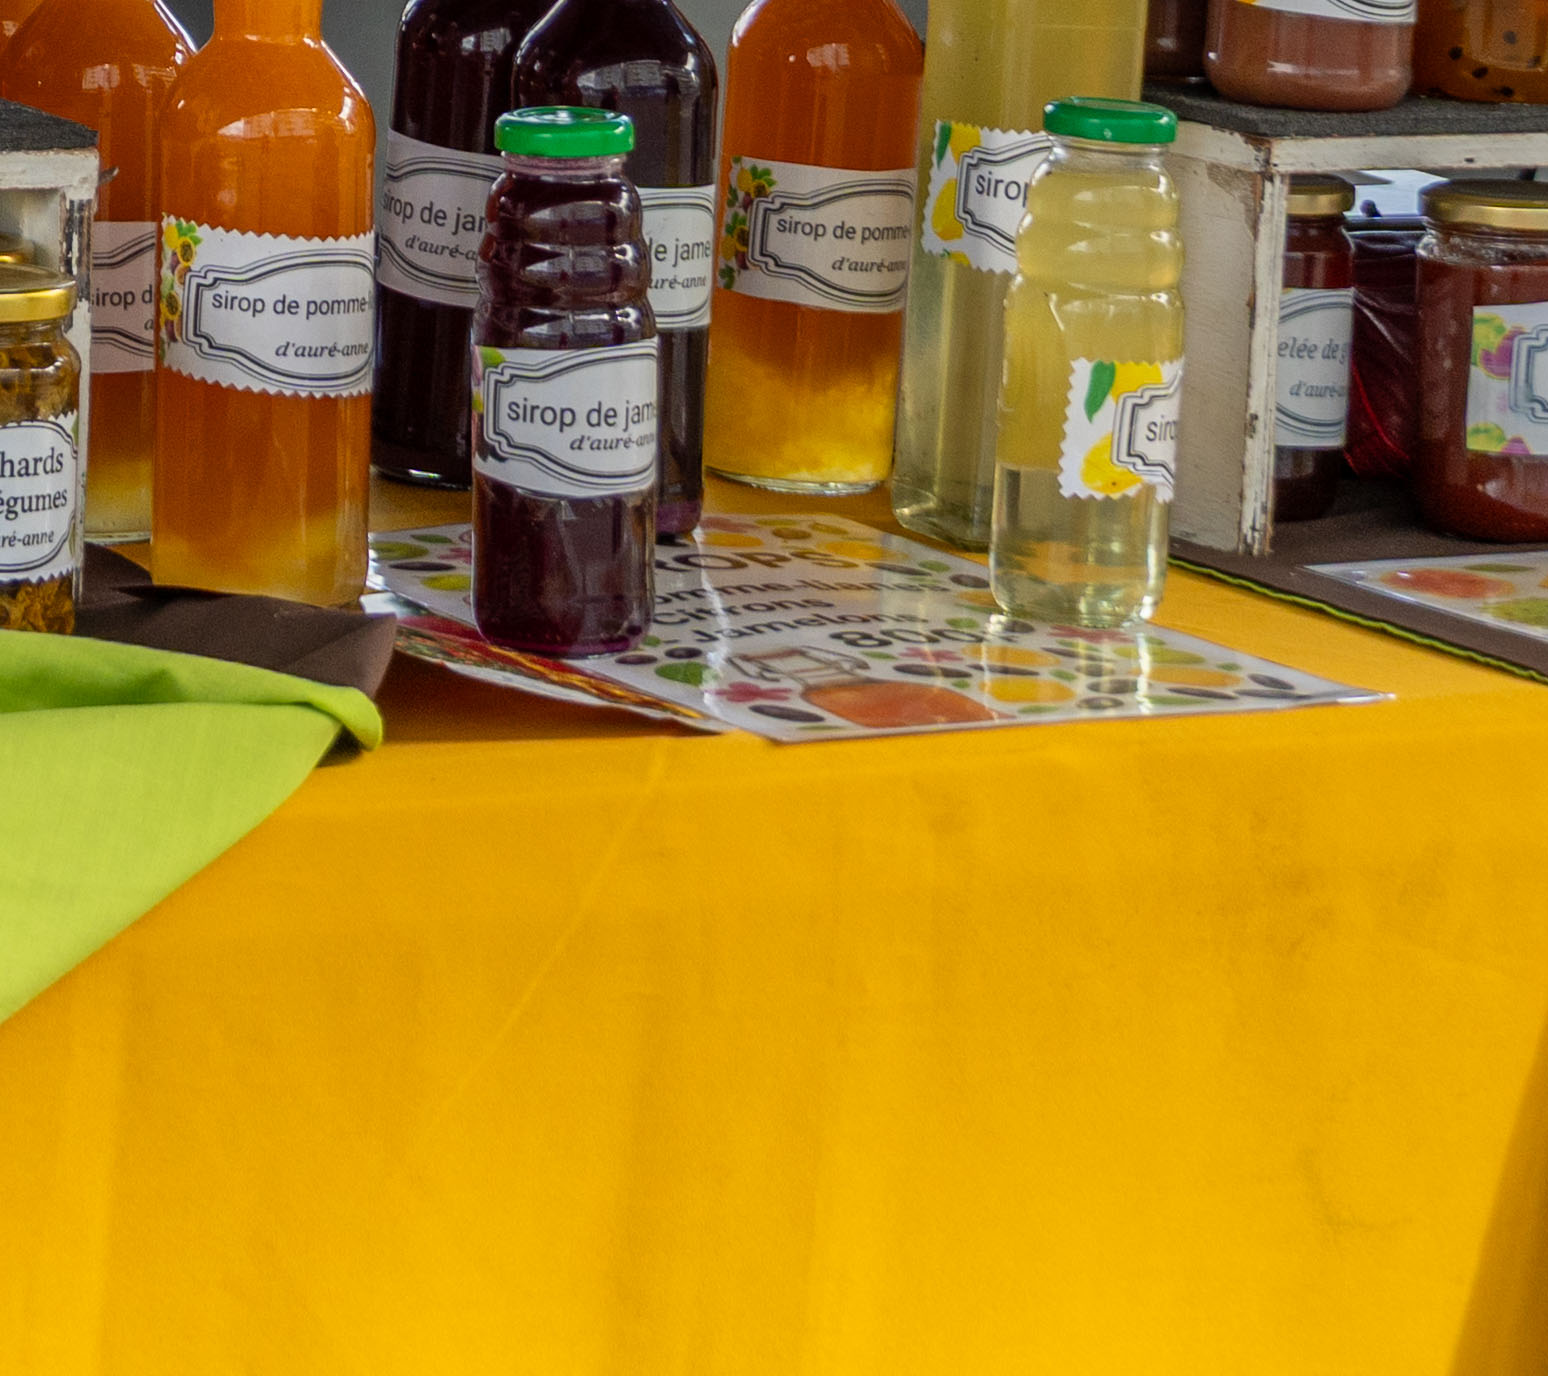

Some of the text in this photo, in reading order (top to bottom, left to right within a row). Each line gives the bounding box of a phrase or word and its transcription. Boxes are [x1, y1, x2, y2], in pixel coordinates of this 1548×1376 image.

[419, 200, 448, 227] de
[775, 214, 826, 240] sirop
[833, 216, 856, 240] de
[211, 288, 264, 318] sirop
[273, 292, 300, 317] de
[1277, 336, 1318, 360] elée
[507, 400, 576, 432] sirop
[586, 399, 618, 428] de
